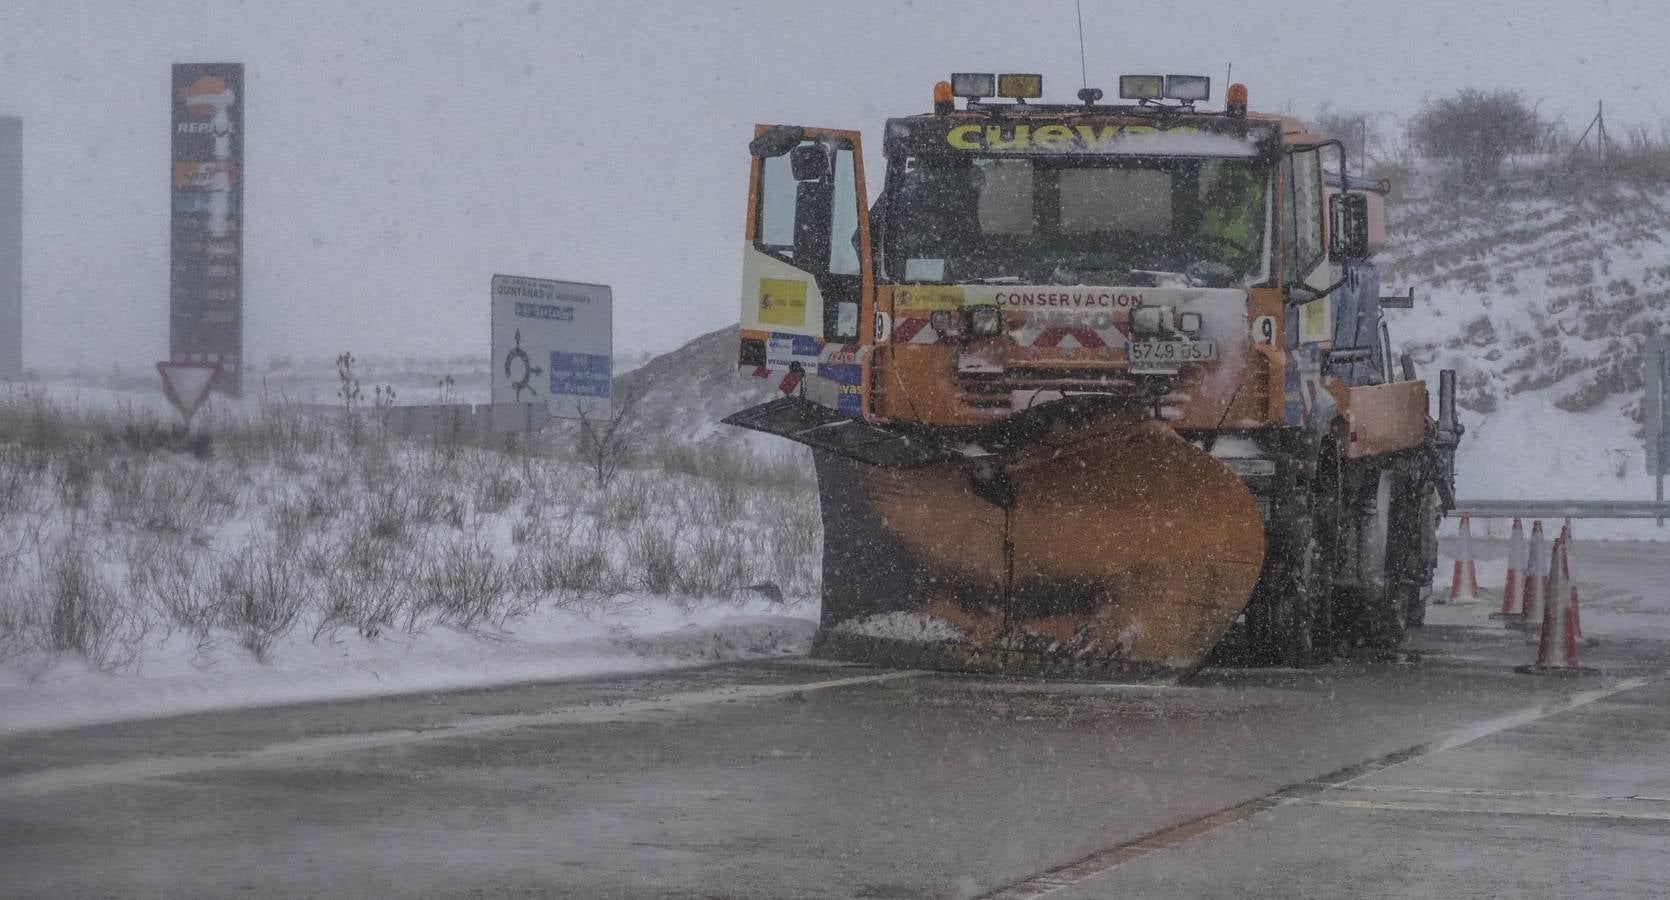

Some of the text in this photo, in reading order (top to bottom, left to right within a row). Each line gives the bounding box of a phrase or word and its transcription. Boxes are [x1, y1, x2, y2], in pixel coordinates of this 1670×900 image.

[947, 124, 1201, 150] cuev
[498, 286, 545, 299] QUINTANAS
[995, 292, 1144, 307] CONSERVACION
[1262, 317, 1272, 345] 9
[1132, 342, 1175, 360] 5749
